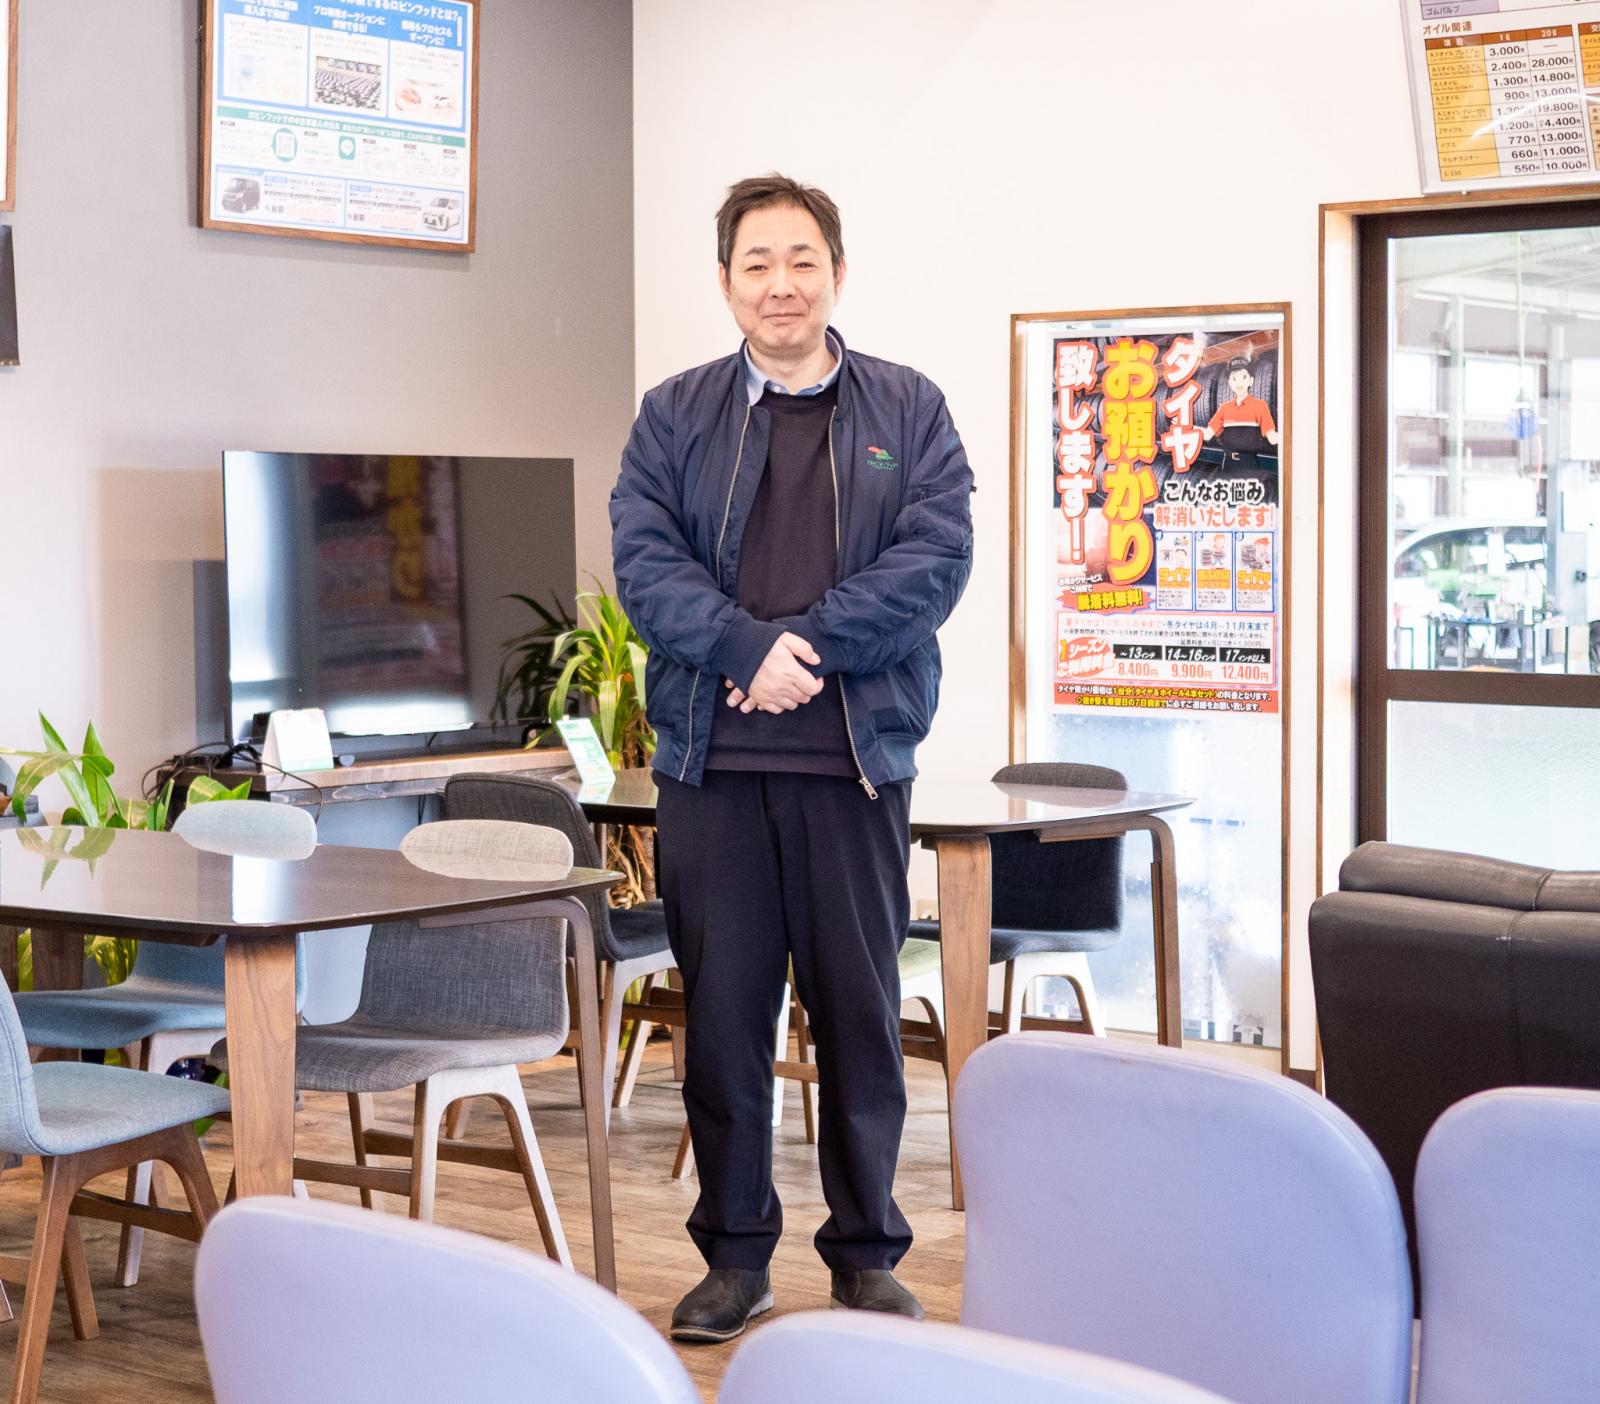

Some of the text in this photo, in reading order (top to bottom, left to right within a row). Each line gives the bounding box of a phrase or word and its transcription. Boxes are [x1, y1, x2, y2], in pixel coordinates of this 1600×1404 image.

[1423, 21, 1472, 35] オイル関連
[1508, 135, 1536, 145] 770円
[1511, 149, 1538, 159] 660円
[1164, 338, 1202, 470] タイヤ
[1104, 340, 1158, 583] お預かり
[1166, 481, 1263, 503] こんなお悩み
[1155, 505, 1275, 527] 解消いたします!
